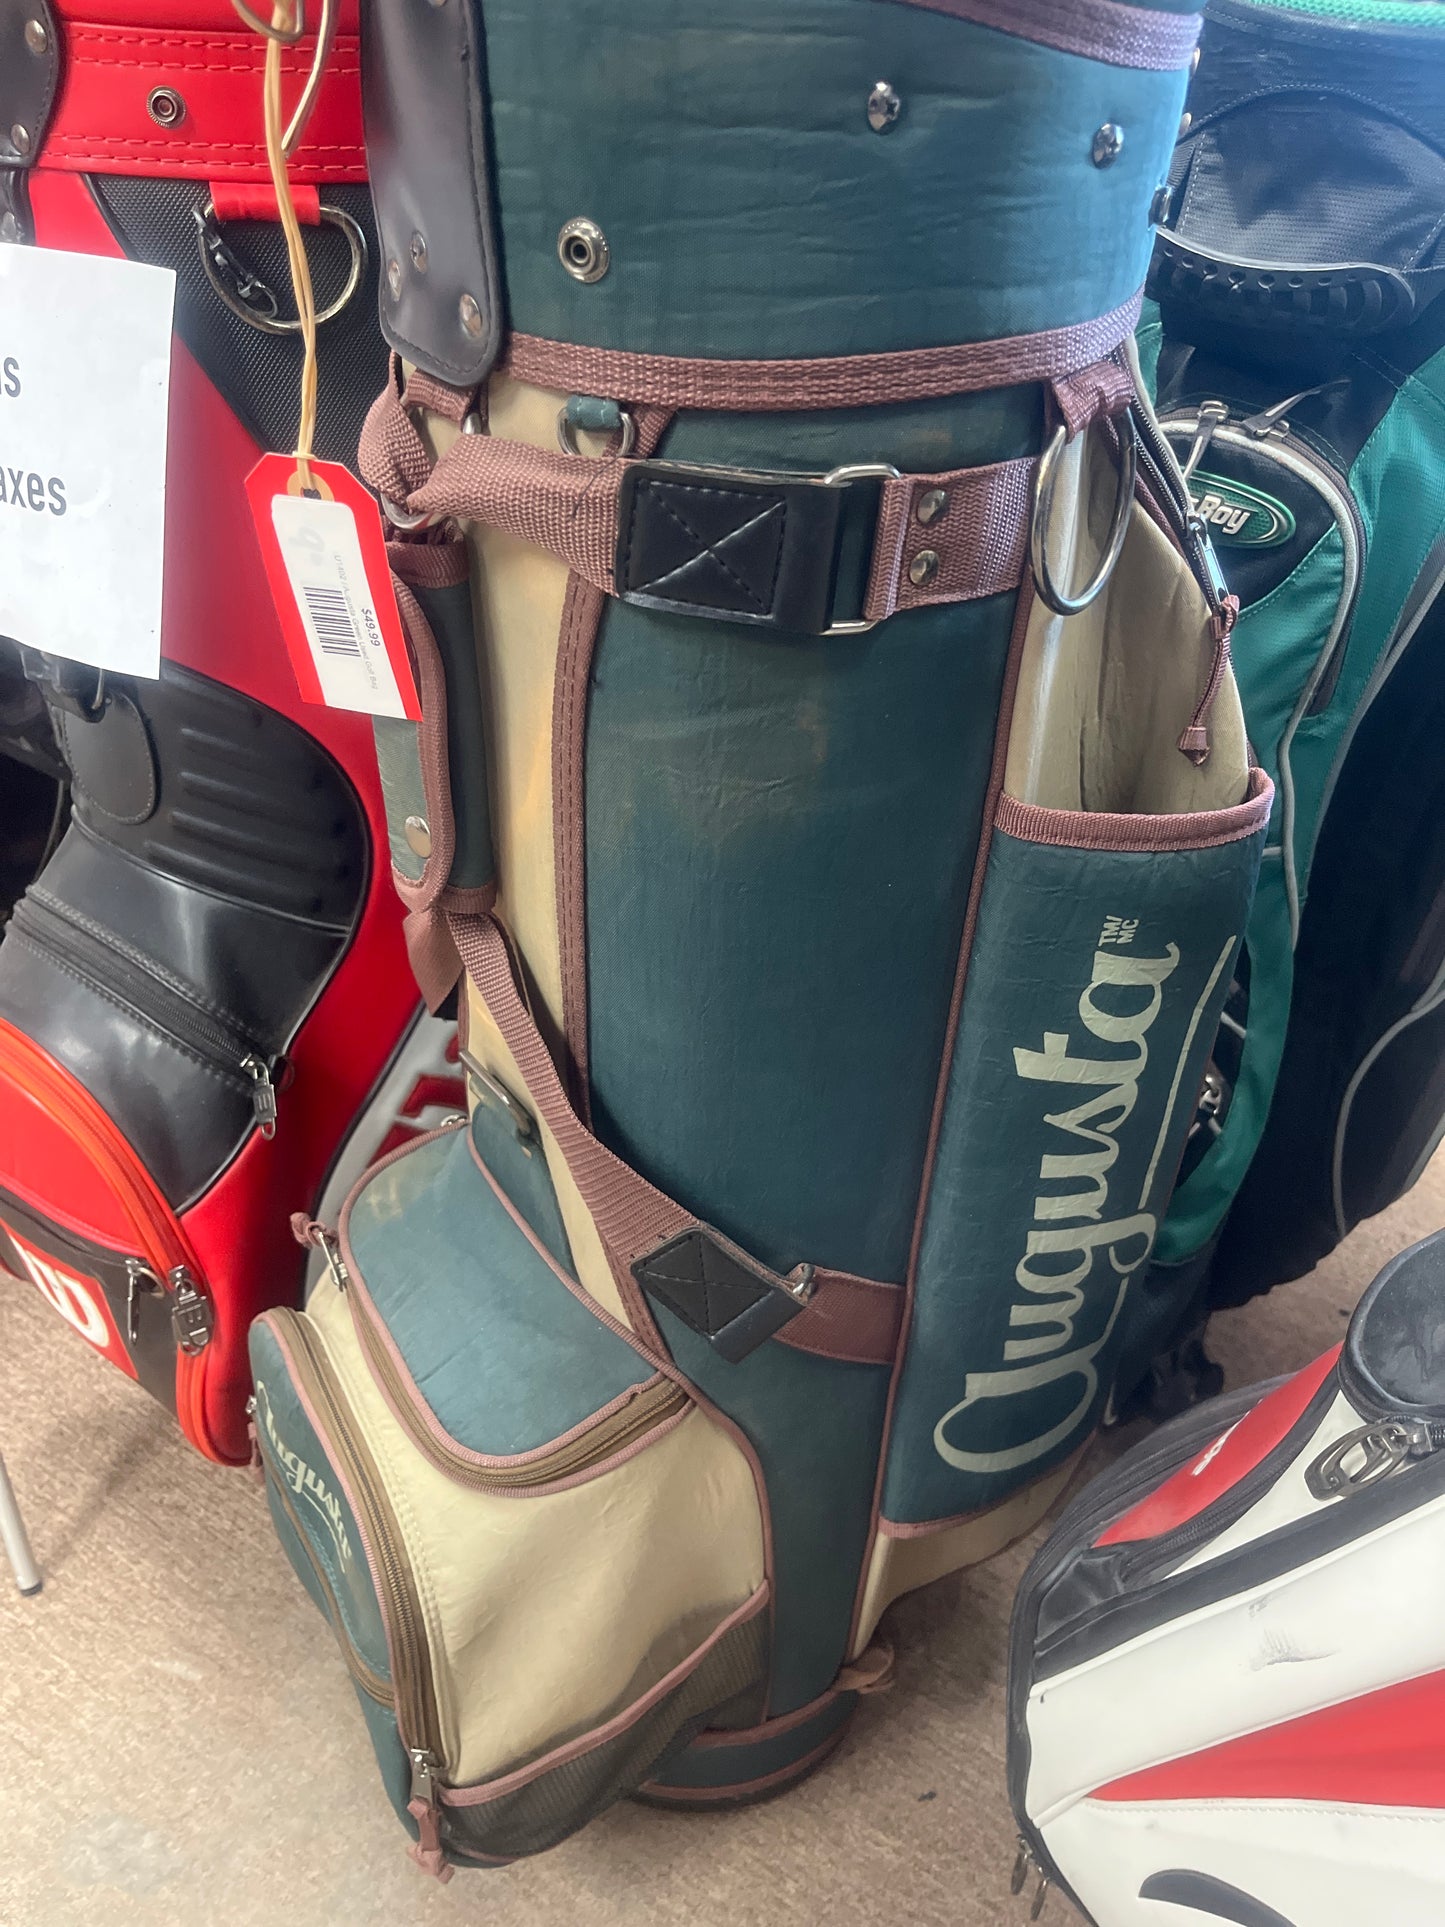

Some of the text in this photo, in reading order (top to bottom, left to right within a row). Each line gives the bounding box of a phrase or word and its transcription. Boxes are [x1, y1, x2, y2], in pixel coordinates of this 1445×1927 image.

[1197, 494, 1251, 535] Boy
[361, 608, 381, 647] $49.99
[1117, 918, 1139, 944] MC
[934, 940, 1181, 1473] Augusta
